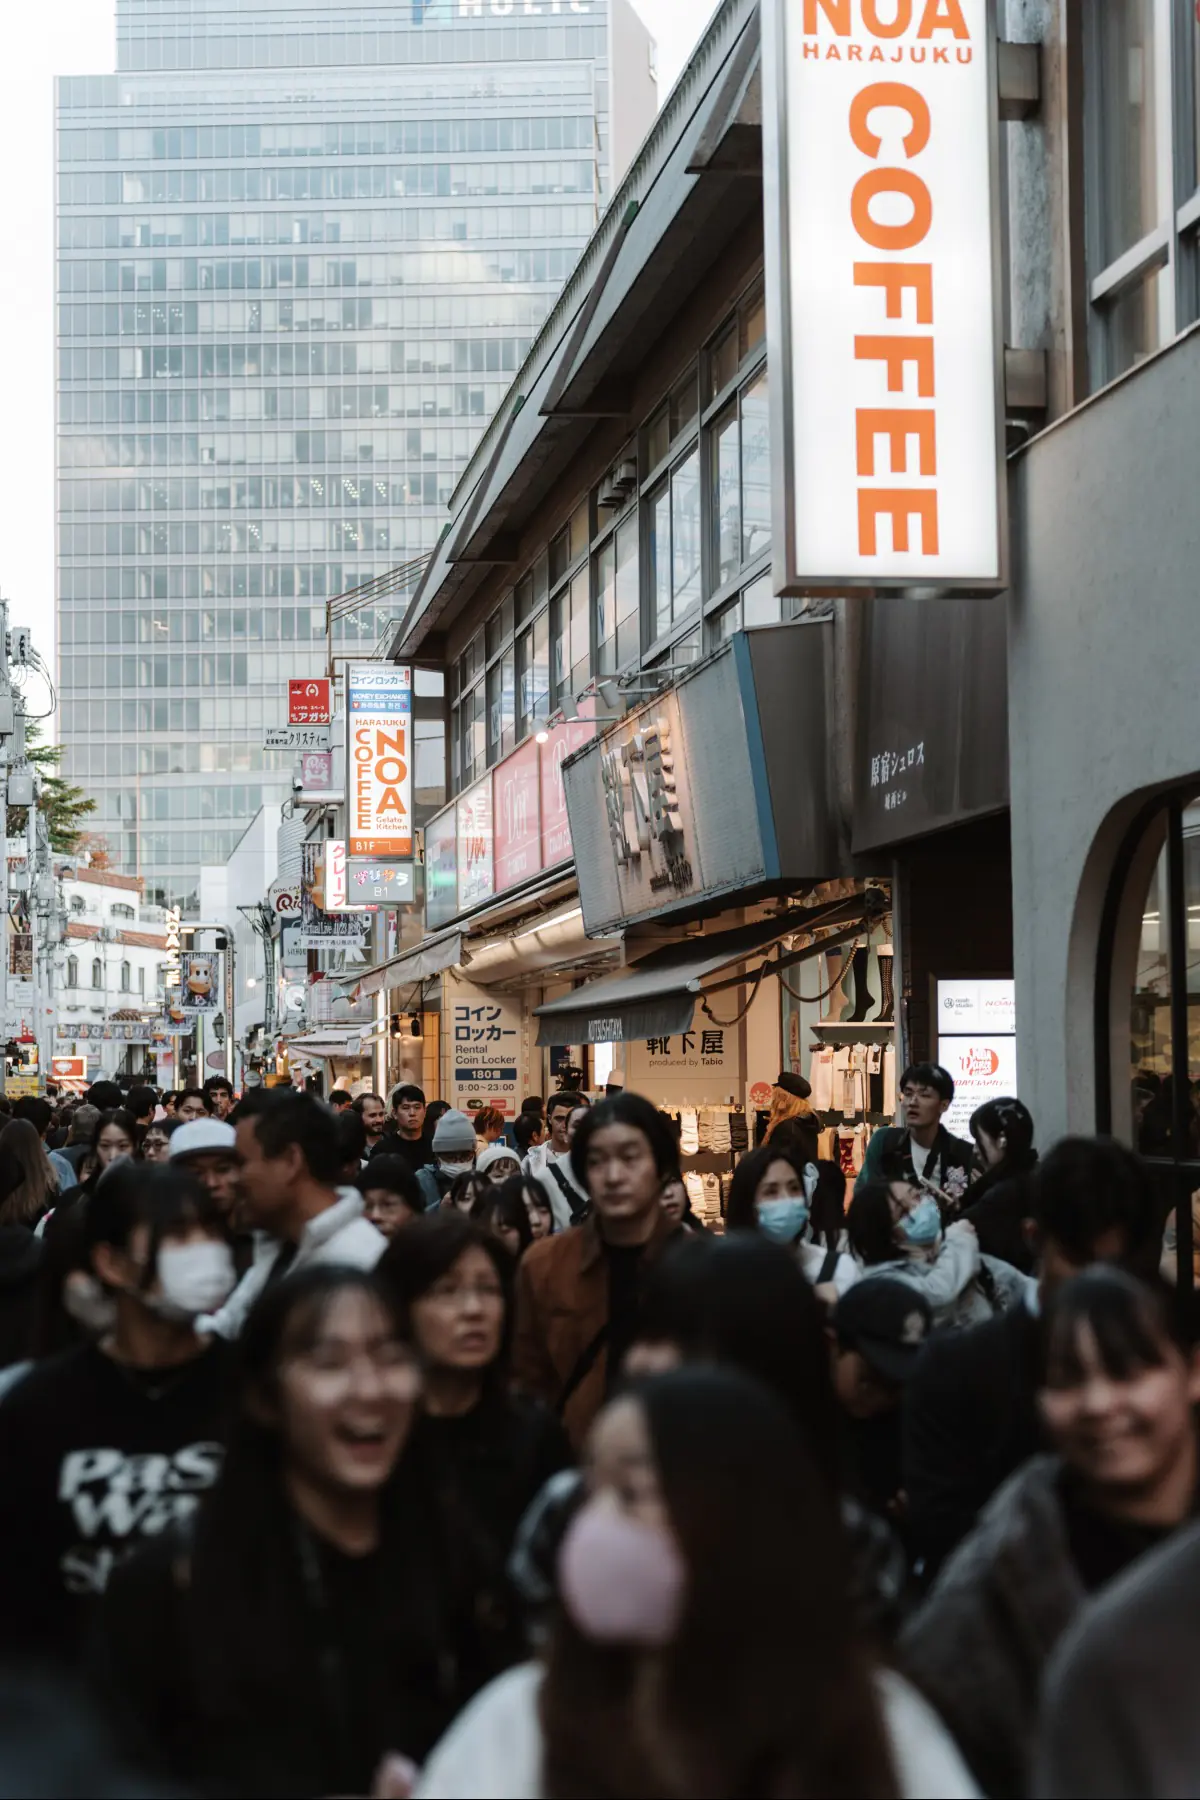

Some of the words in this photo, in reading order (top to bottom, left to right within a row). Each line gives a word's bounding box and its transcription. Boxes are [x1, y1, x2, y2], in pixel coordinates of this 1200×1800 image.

[803, 43, 973, 64] HARAJUKU
[848, 81, 939, 556] COFFEE
[351, 676, 404, 685] コインロッカー
[352, 693, 375, 701] MONEY
[375, 693, 408, 701] EXCHANGE
[298, 712, 329, 722] アガサ
[289, 732, 328, 746] クリスティー
[374, 729, 407, 815] NOA
[354, 728, 374, 830] COFFEE
[355, 841, 376, 852] B1F
[374, 886, 388, 897] B1
[455, 1006, 502, 1021] コイン
[455, 1025, 516, 1041] ロッカー
[588, 1017, 623, 1042] KUTSUSHITAYA
[455, 1045, 488, 1054] Rental
[455, 1055, 479, 1064] Coin
[482, 1055, 516, 1064] Locker
[649, 1058, 687, 1067] produced
[688, 1058, 698, 1067] by
[701, 1058, 723, 1066] Tabio
